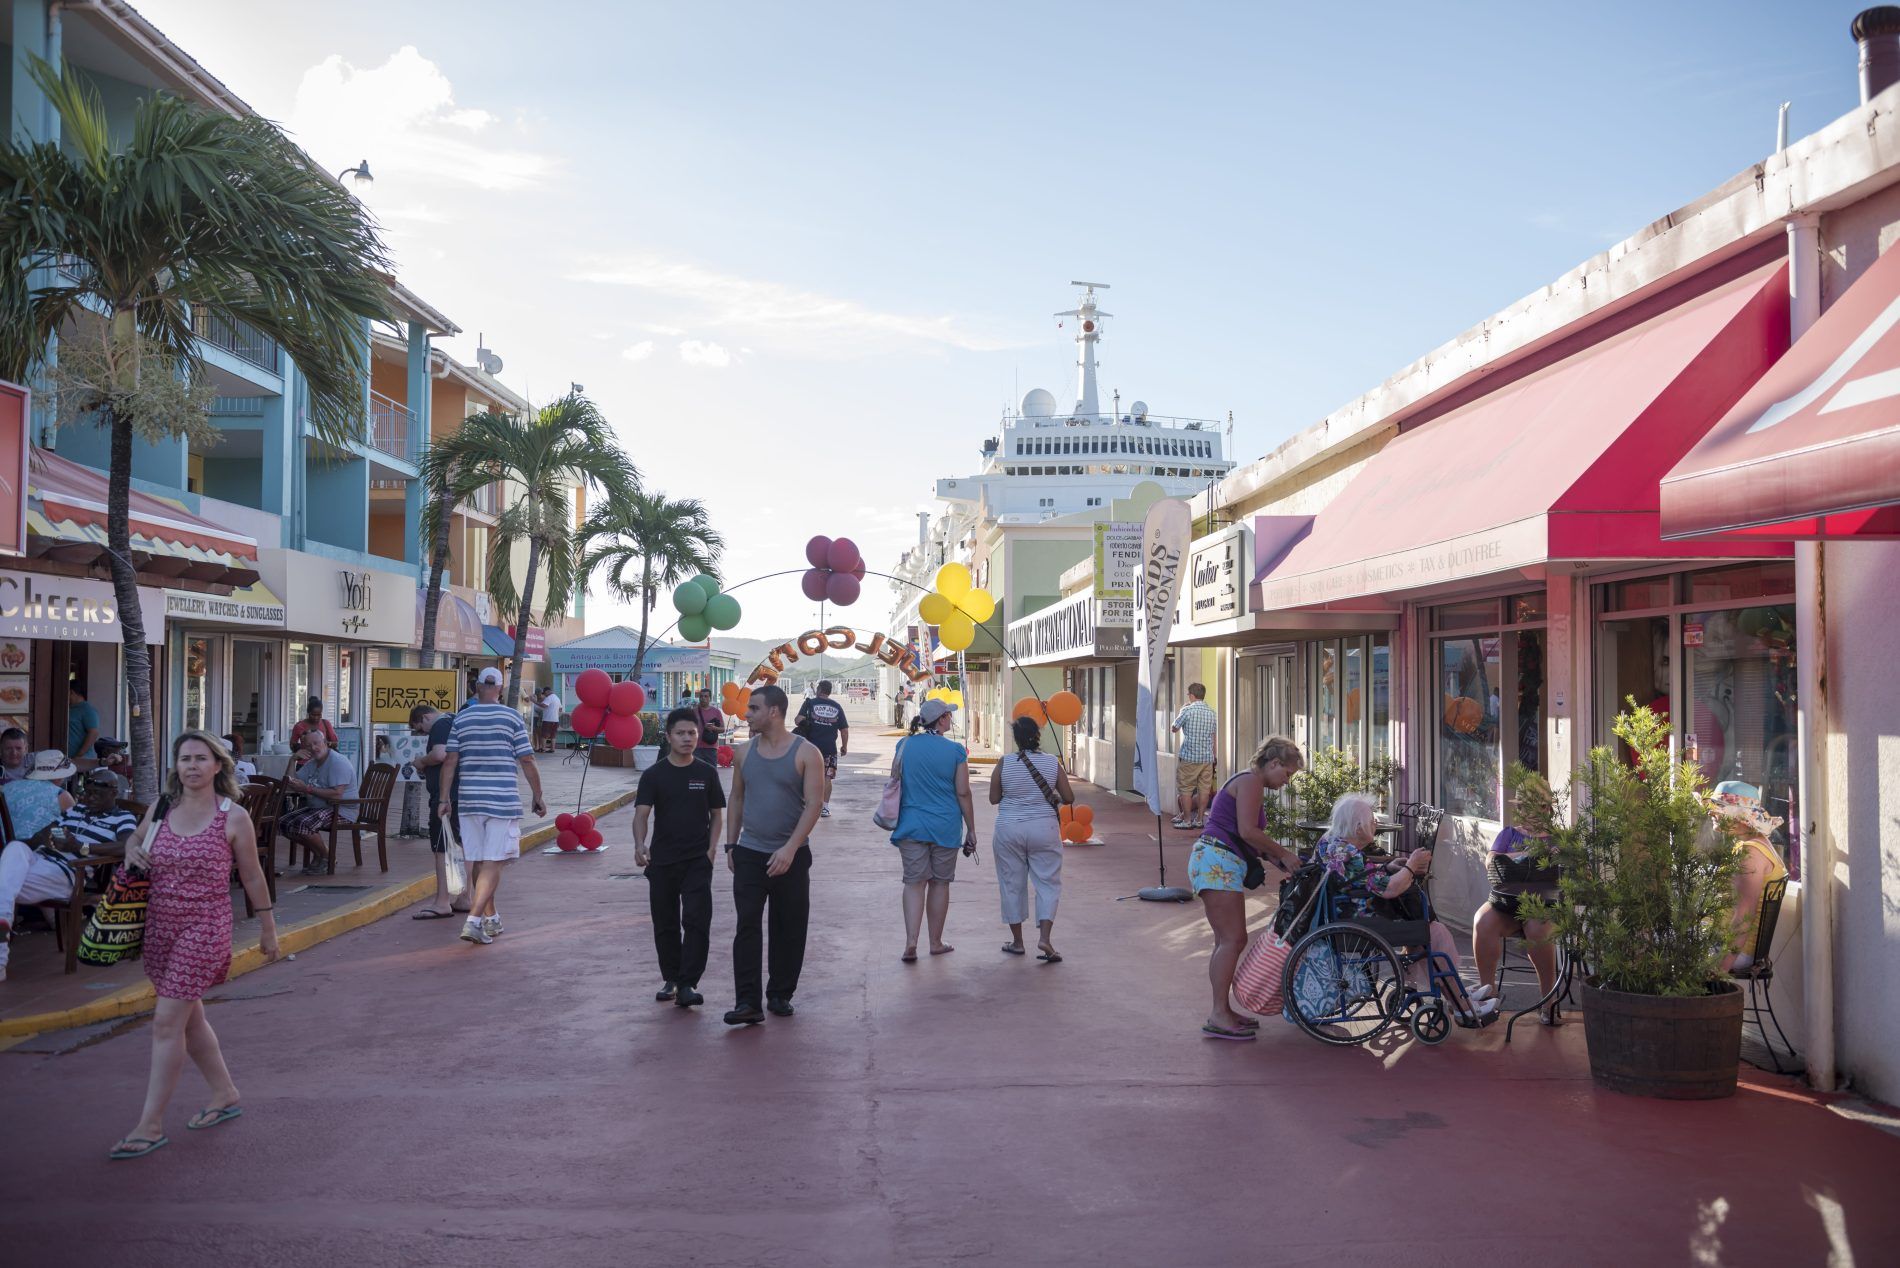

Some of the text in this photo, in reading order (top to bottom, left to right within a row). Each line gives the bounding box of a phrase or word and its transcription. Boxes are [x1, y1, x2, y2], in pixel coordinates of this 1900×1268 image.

[1420, 556, 1436, 573] TAX
[208, 601, 239, 617] WATCHES
[240, 605, 246, 618] &
[246, 606, 284, 621] SUNGLASSES
[1102, 609, 1120, 617] FOR
[20, 623, 89, 638] ANTIGUA
[570, 653, 602, 661] Antigua
[375, 687, 431, 699] FIRST
